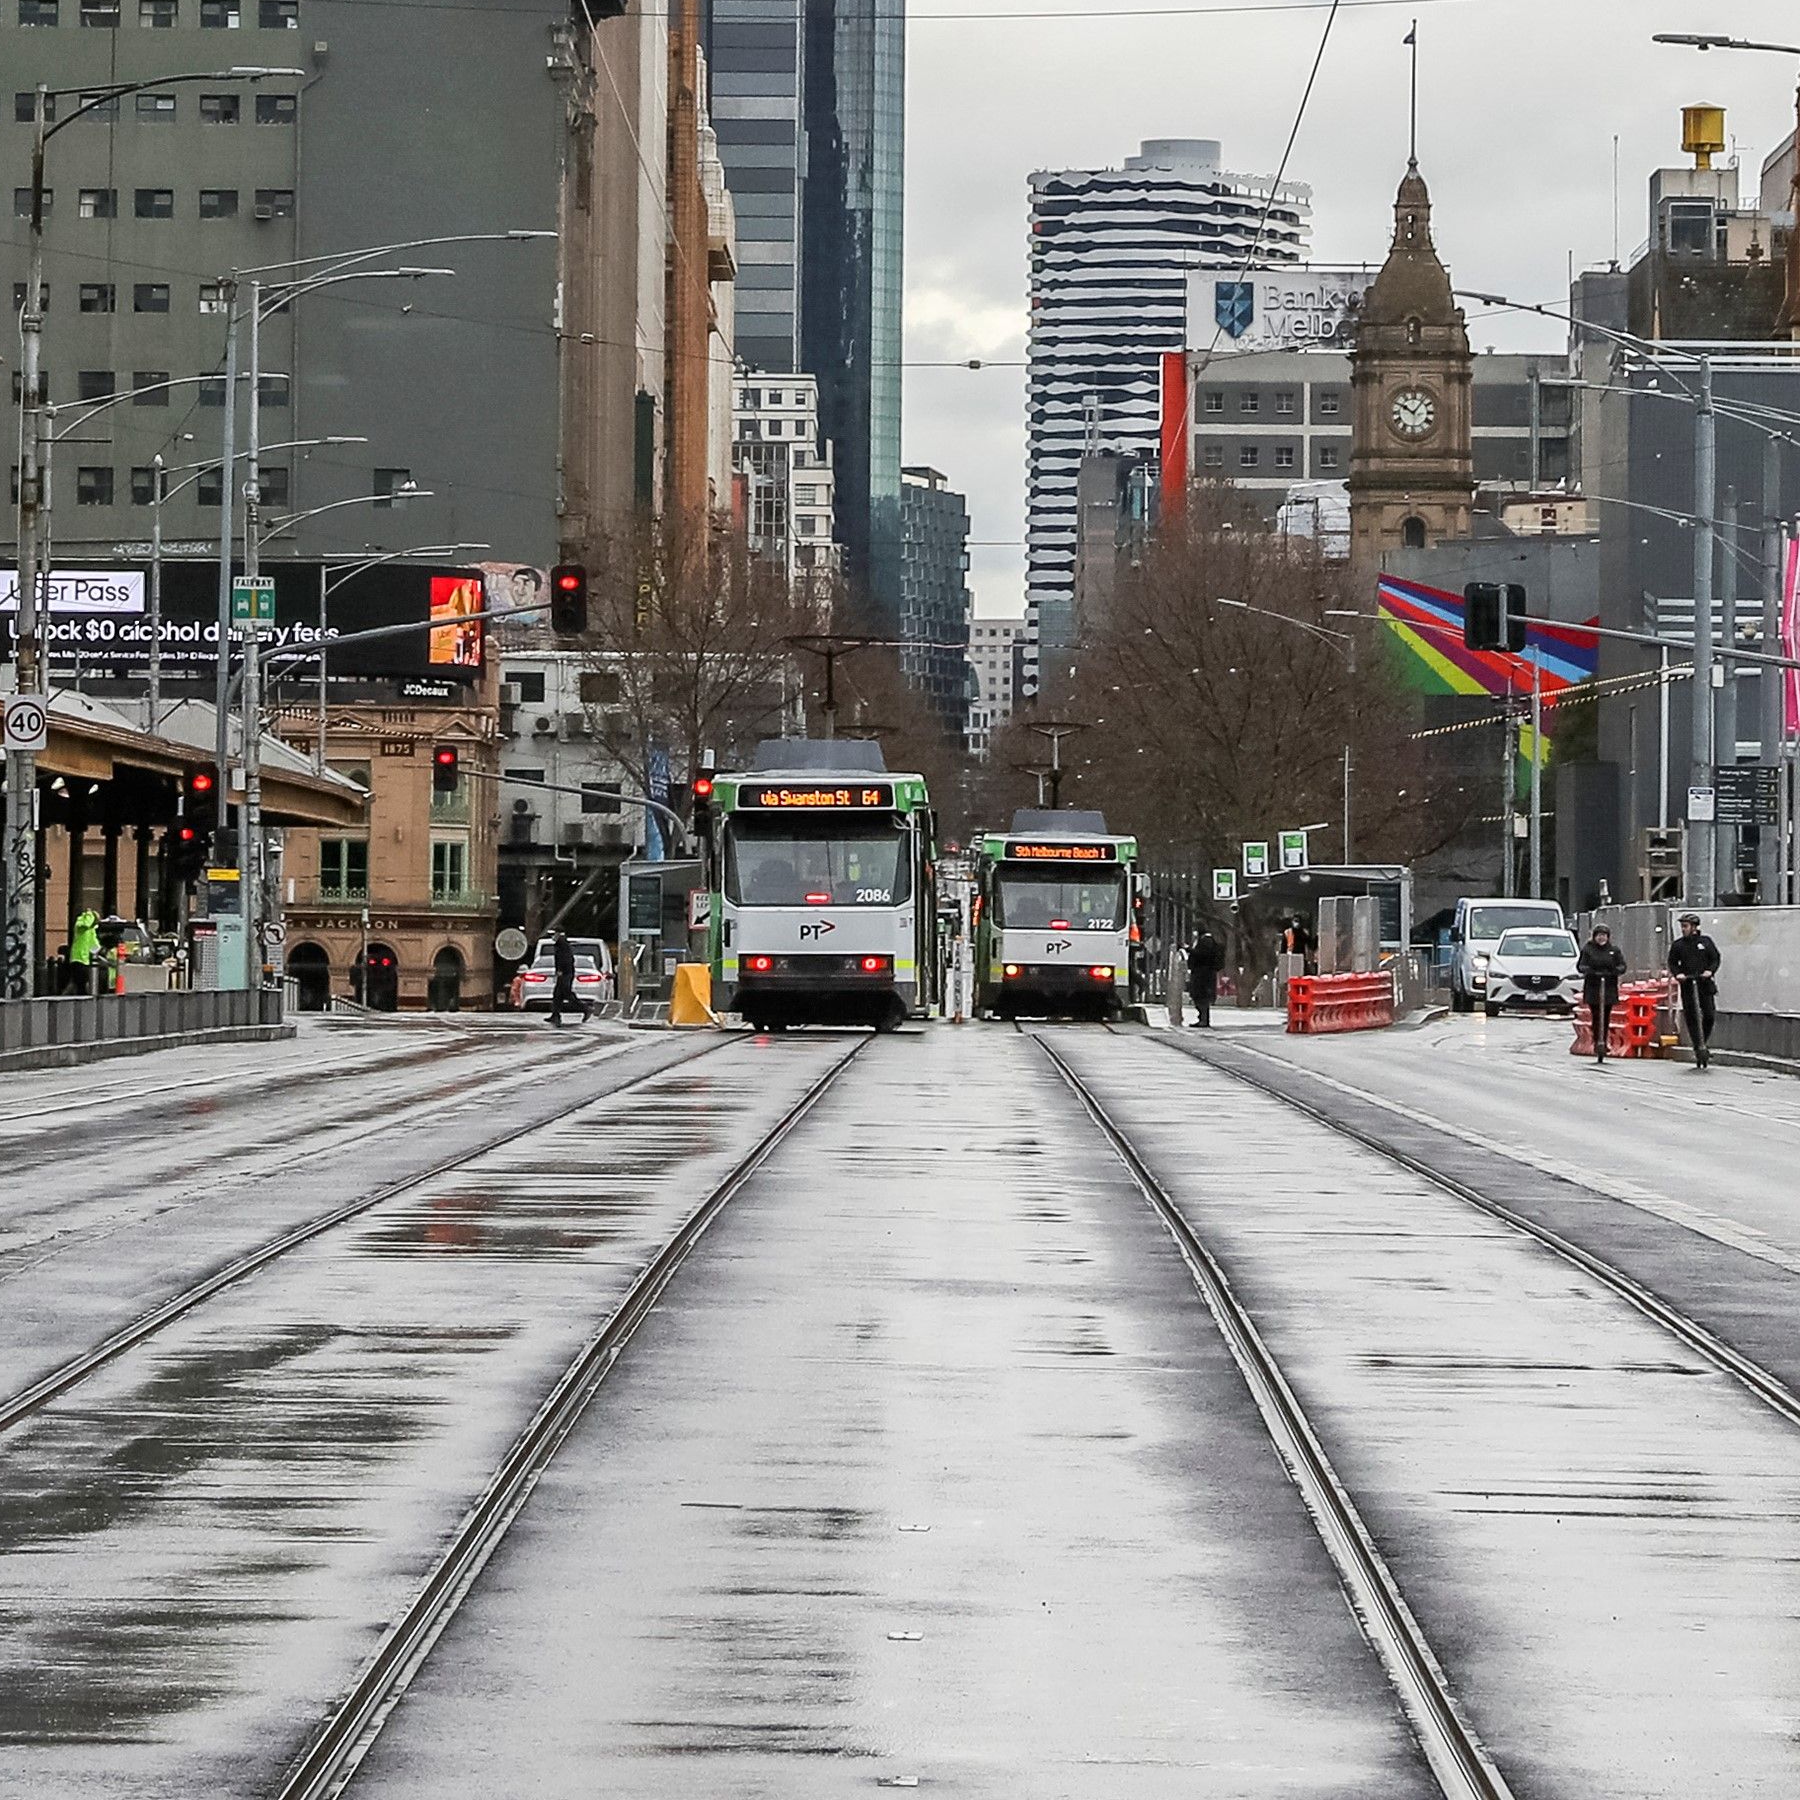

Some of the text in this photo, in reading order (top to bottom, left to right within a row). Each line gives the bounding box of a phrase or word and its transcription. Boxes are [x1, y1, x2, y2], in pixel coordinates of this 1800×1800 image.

[1263, 285, 1338, 311] Bank
[75, 579, 130, 601] Pass
[85, 619, 116, 642] $0
[403, 684, 448, 697] JCDecaux
[11, 712, 41, 732] 40
[761, 790, 879, 805] via Swanston St 64
[1032, 846, 1072, 858] Melbourne
[1073, 847, 1099, 859] Beach
[856, 889, 891, 902] 2086
[315, 919, 399, 929] JACKON
[1088, 918, 1114, 930] 2122
